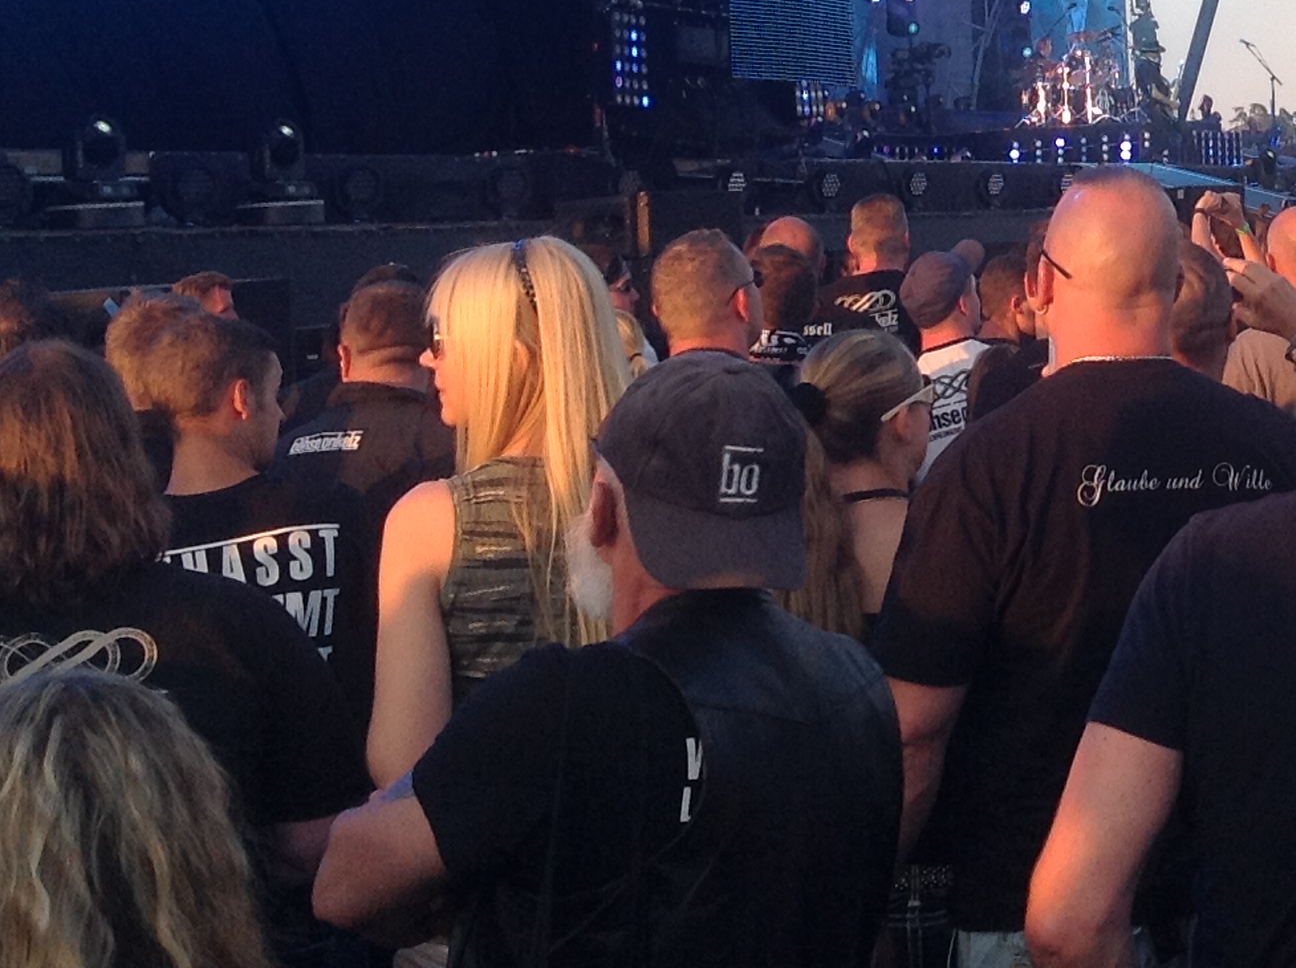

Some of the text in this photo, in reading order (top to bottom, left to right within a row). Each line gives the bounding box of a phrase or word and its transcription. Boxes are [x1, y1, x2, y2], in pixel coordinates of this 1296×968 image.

[1076, 462, 1272, 507] Glaube und Wille
